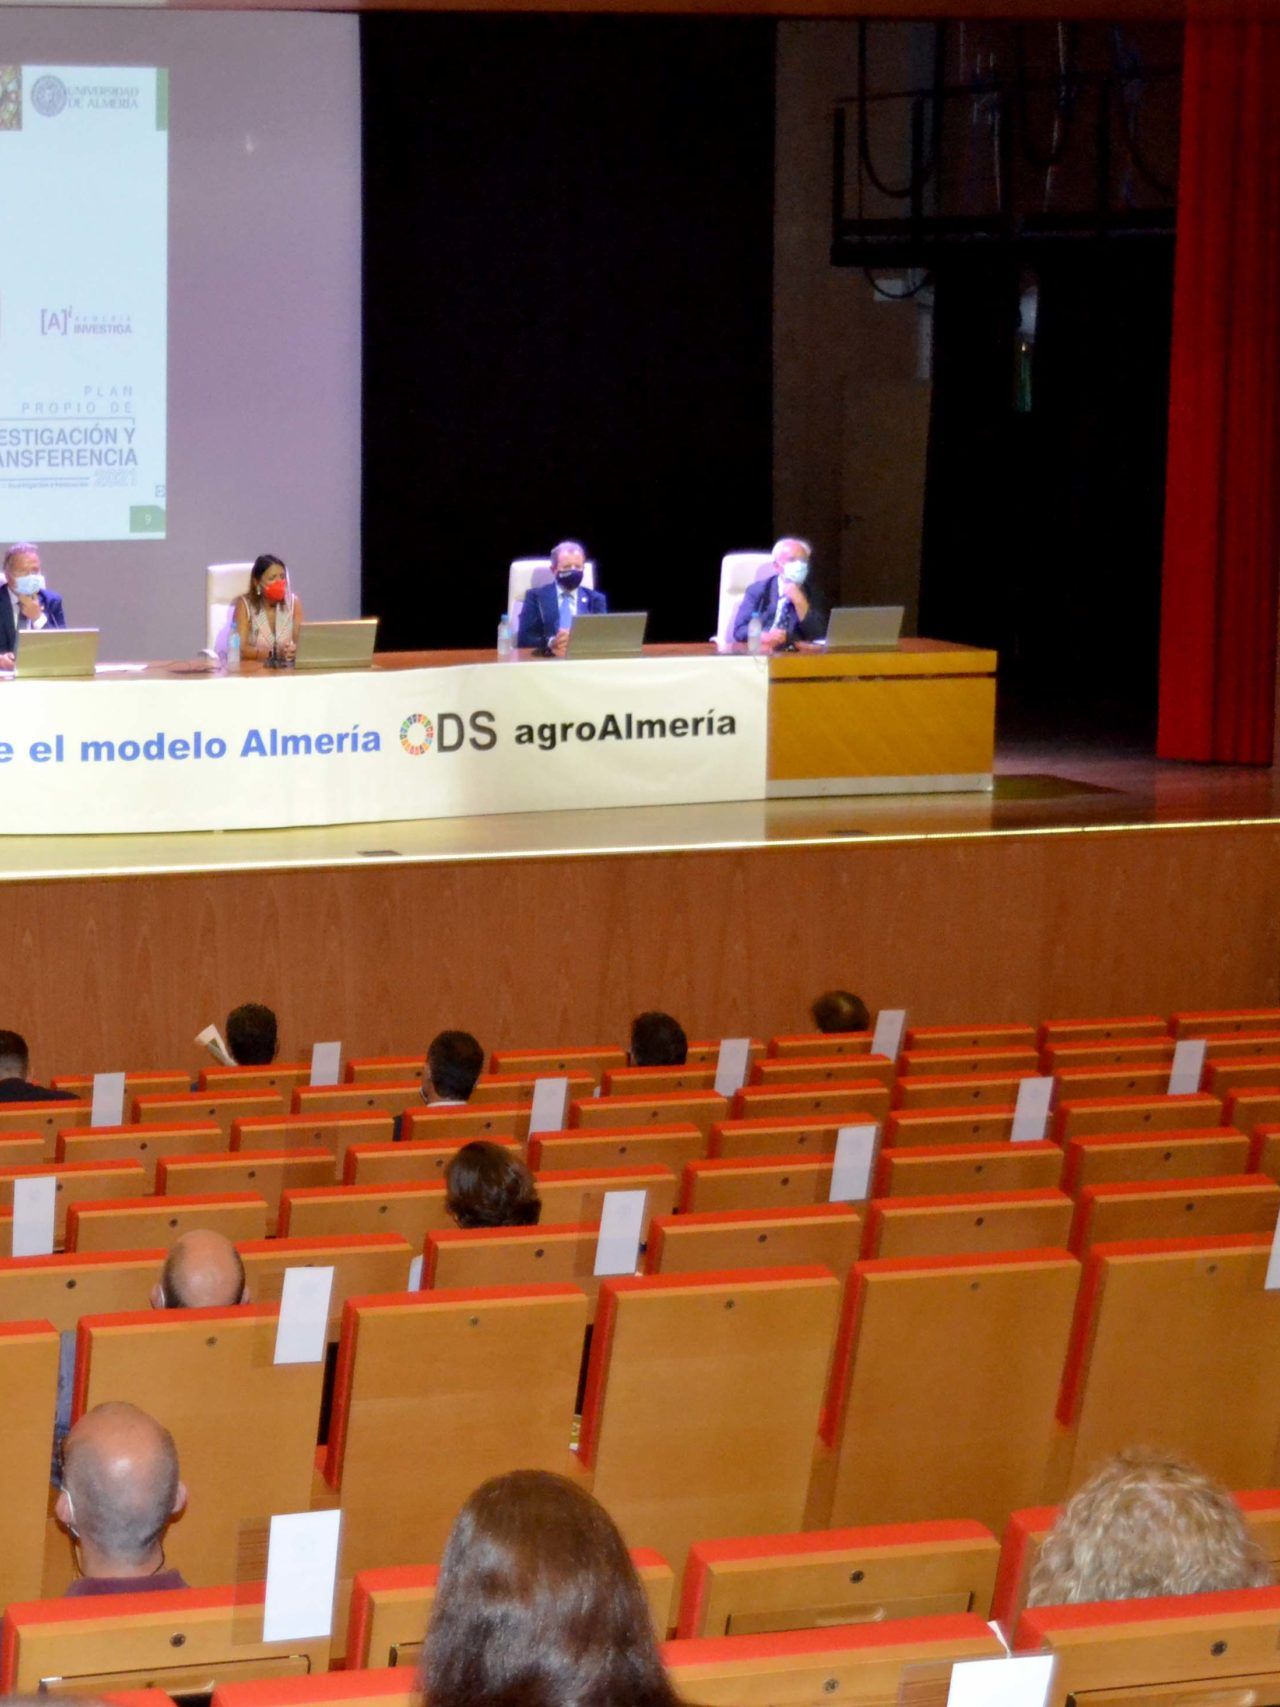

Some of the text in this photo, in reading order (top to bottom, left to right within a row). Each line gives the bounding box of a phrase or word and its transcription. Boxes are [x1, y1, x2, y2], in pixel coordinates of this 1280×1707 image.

[73, 323, 133, 335] INVESTIGA
[83, 385, 133, 397] PLAN
[21, 401, 133, 414] PROPIO DE
[124, 427, 136, 444] Y
[29, 734, 64, 762] el
[80, 731, 227, 762] modelo
[239, 724, 381, 758] Almería
[514, 709, 737, 751] agroAlmería
